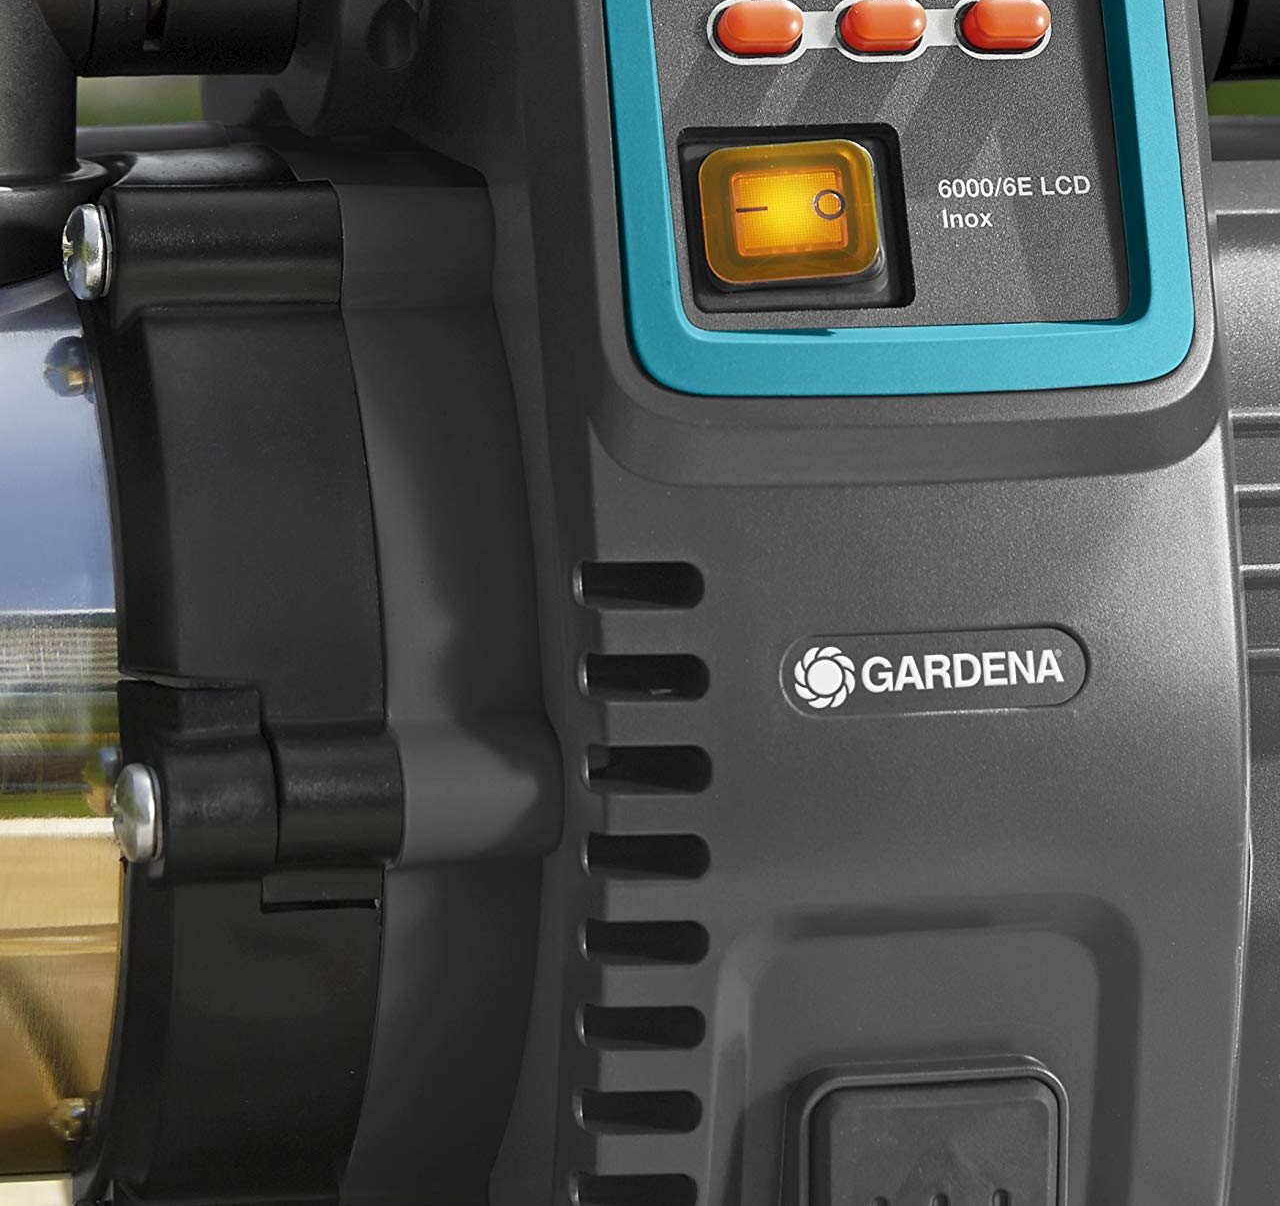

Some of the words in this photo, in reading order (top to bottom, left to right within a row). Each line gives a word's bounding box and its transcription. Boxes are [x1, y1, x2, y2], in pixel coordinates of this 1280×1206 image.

[937, 177, 1033, 198] 6000/6E
[1040, 175, 1091, 196] LCD
[941, 208, 994, 230] Inox
[861, 649, 1064, 693] GARDENA
